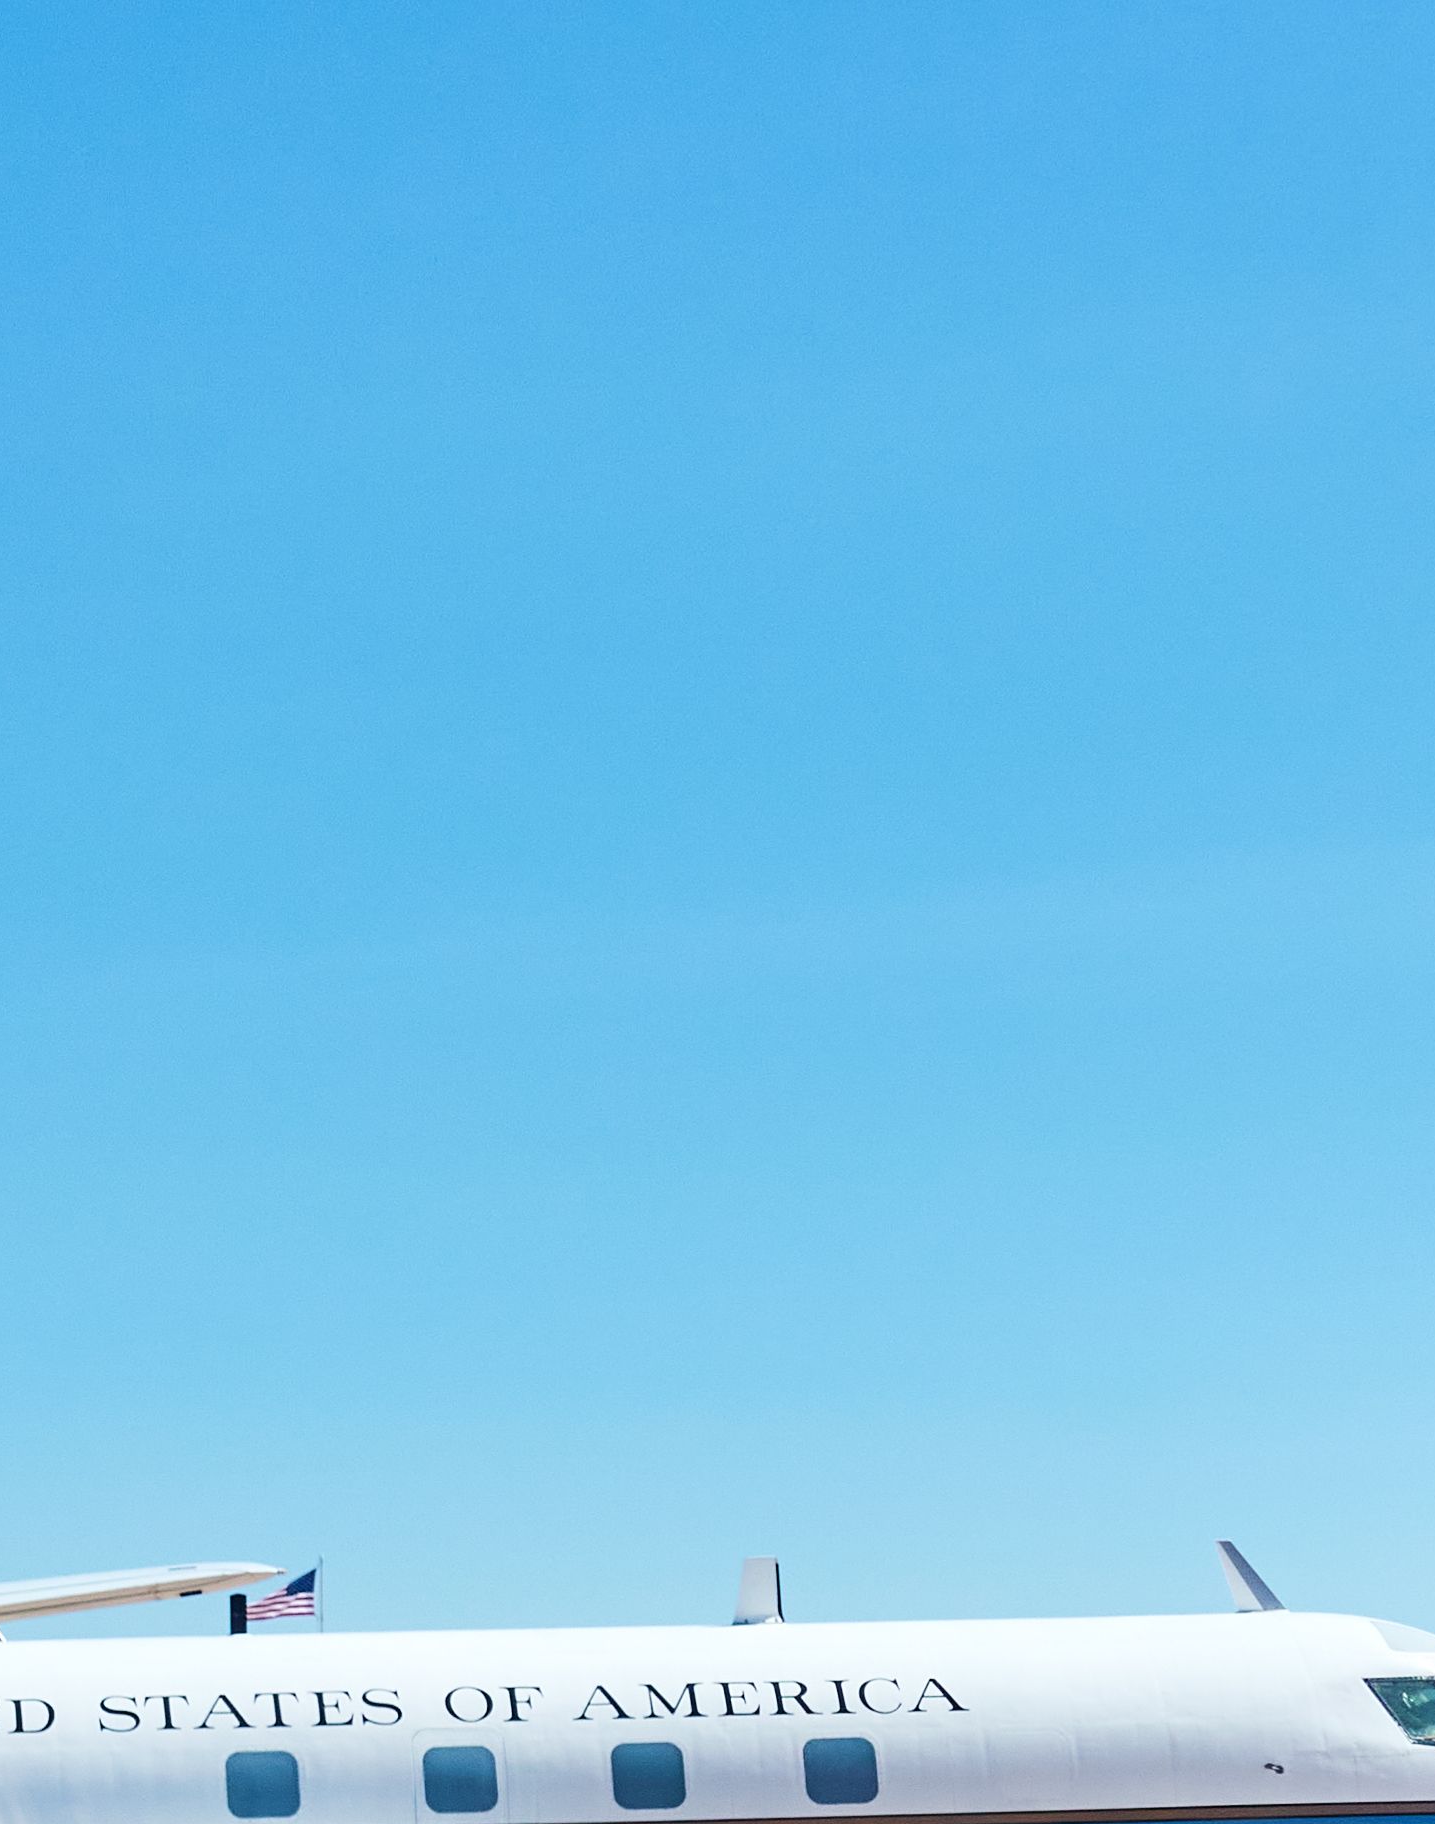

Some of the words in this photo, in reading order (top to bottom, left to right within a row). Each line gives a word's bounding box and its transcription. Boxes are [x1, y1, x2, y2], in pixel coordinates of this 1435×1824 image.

[98, 1689, 404, 1732] STATES
[444, 1685, 544, 1723] OF
[572, 1677, 970, 1720] AMERICA
